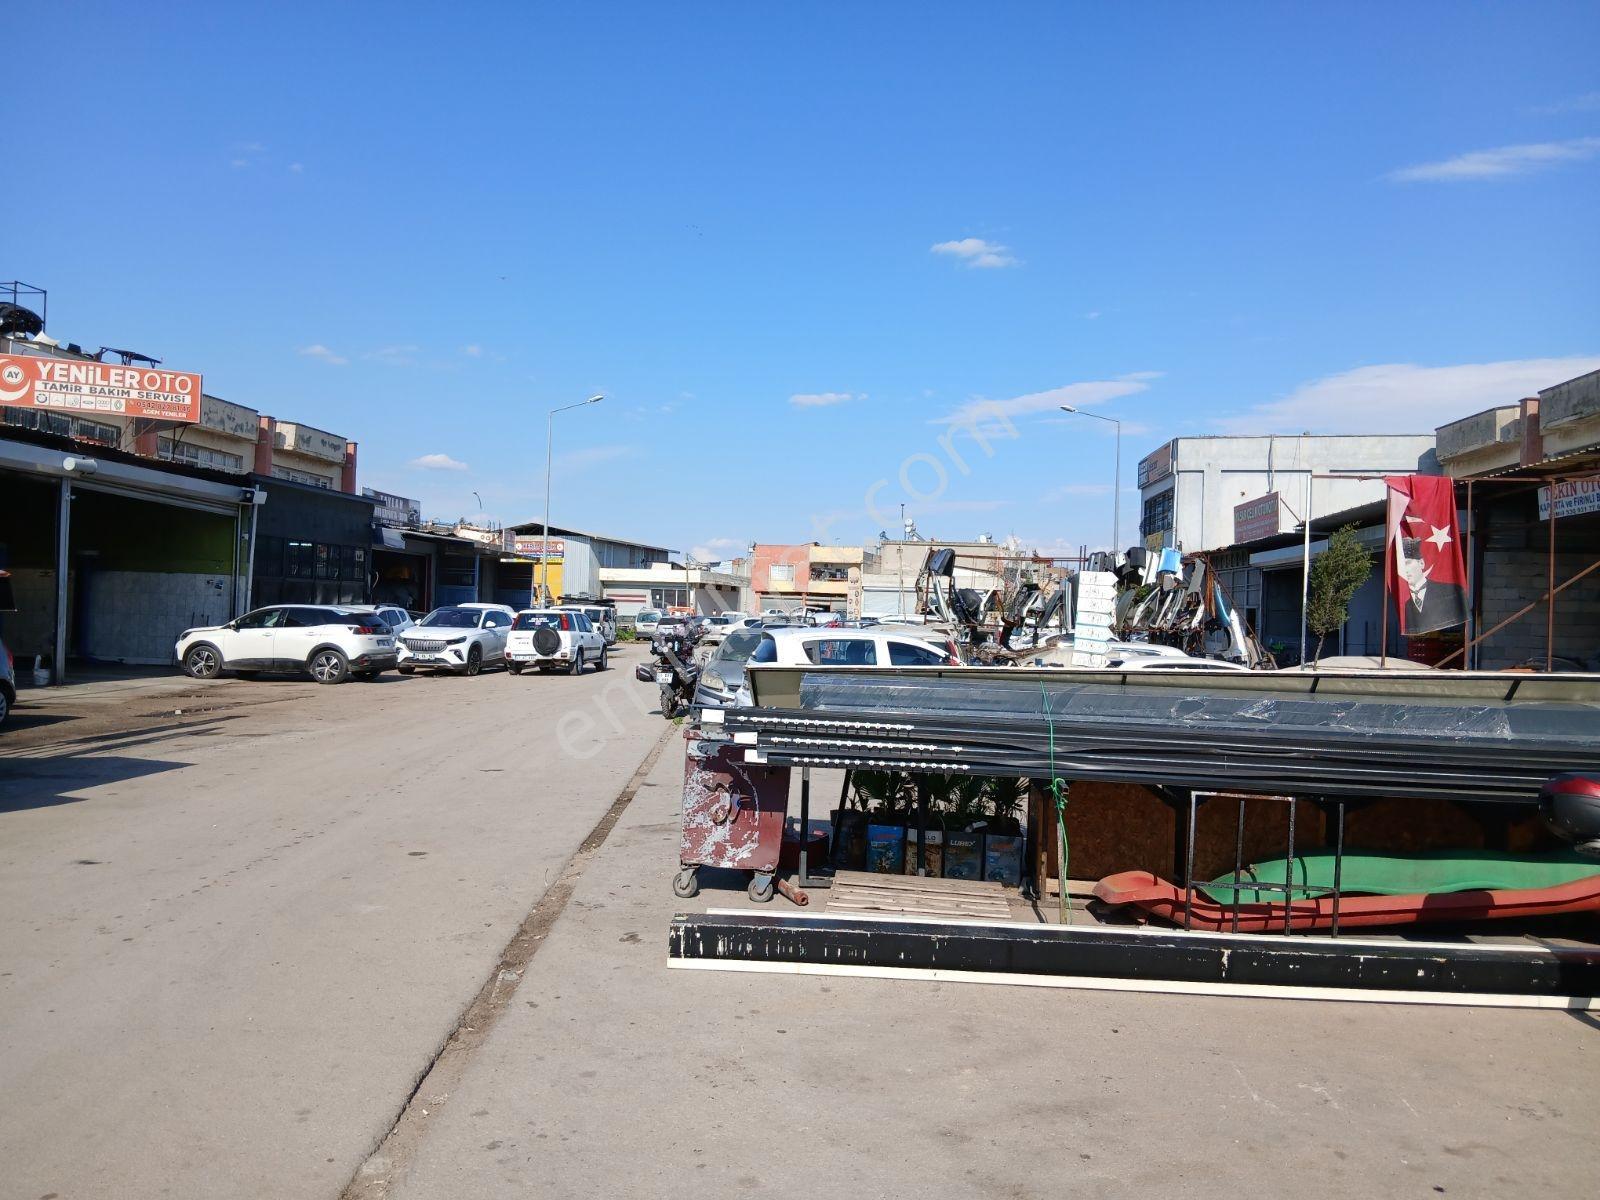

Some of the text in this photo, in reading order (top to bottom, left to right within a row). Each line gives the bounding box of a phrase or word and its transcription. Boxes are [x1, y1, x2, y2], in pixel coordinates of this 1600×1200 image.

[7, 371, 20, 379] AY
[143, 372, 192, 394] OTO
[89, 386, 131, 398] BAKIM
[1540, 500, 1564, 512] KAPRTA
